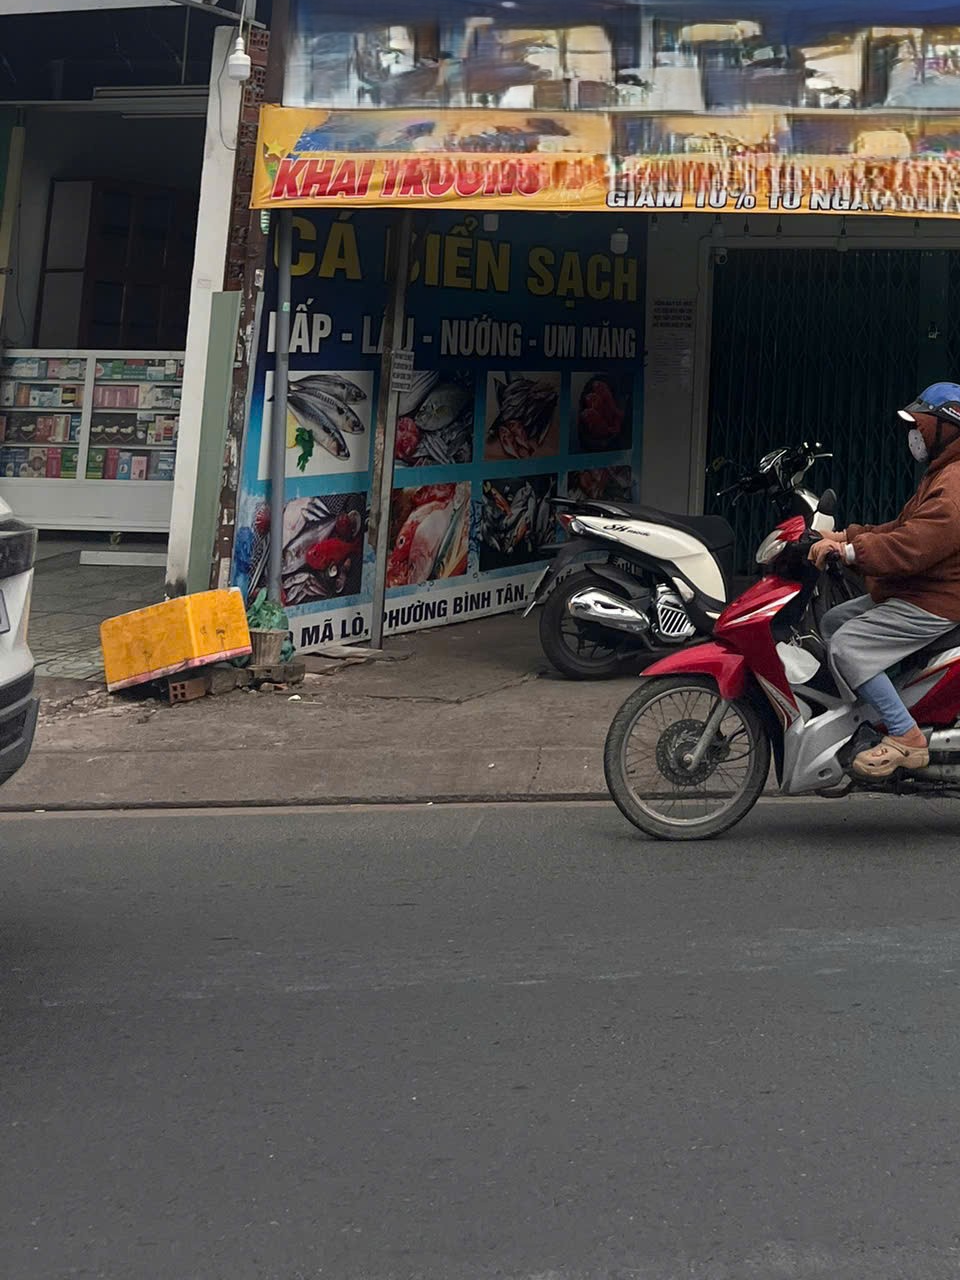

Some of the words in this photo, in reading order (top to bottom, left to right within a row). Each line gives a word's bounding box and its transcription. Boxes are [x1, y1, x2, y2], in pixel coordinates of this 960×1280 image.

[271, 157, 376, 200] KHAI
[273, 210, 362, 281] CÁ
[528, 247, 637, 309] SẠCH
[441, 313, 522, 359] NƯỚNG
[544, 324, 587, 358] UM
[591, 320, 637, 359] MĂNG
[301, 618, 334, 647] MÃ
[453, 592, 491, 615] BÌNH
[496, 583, 528, 605] TÂN,
